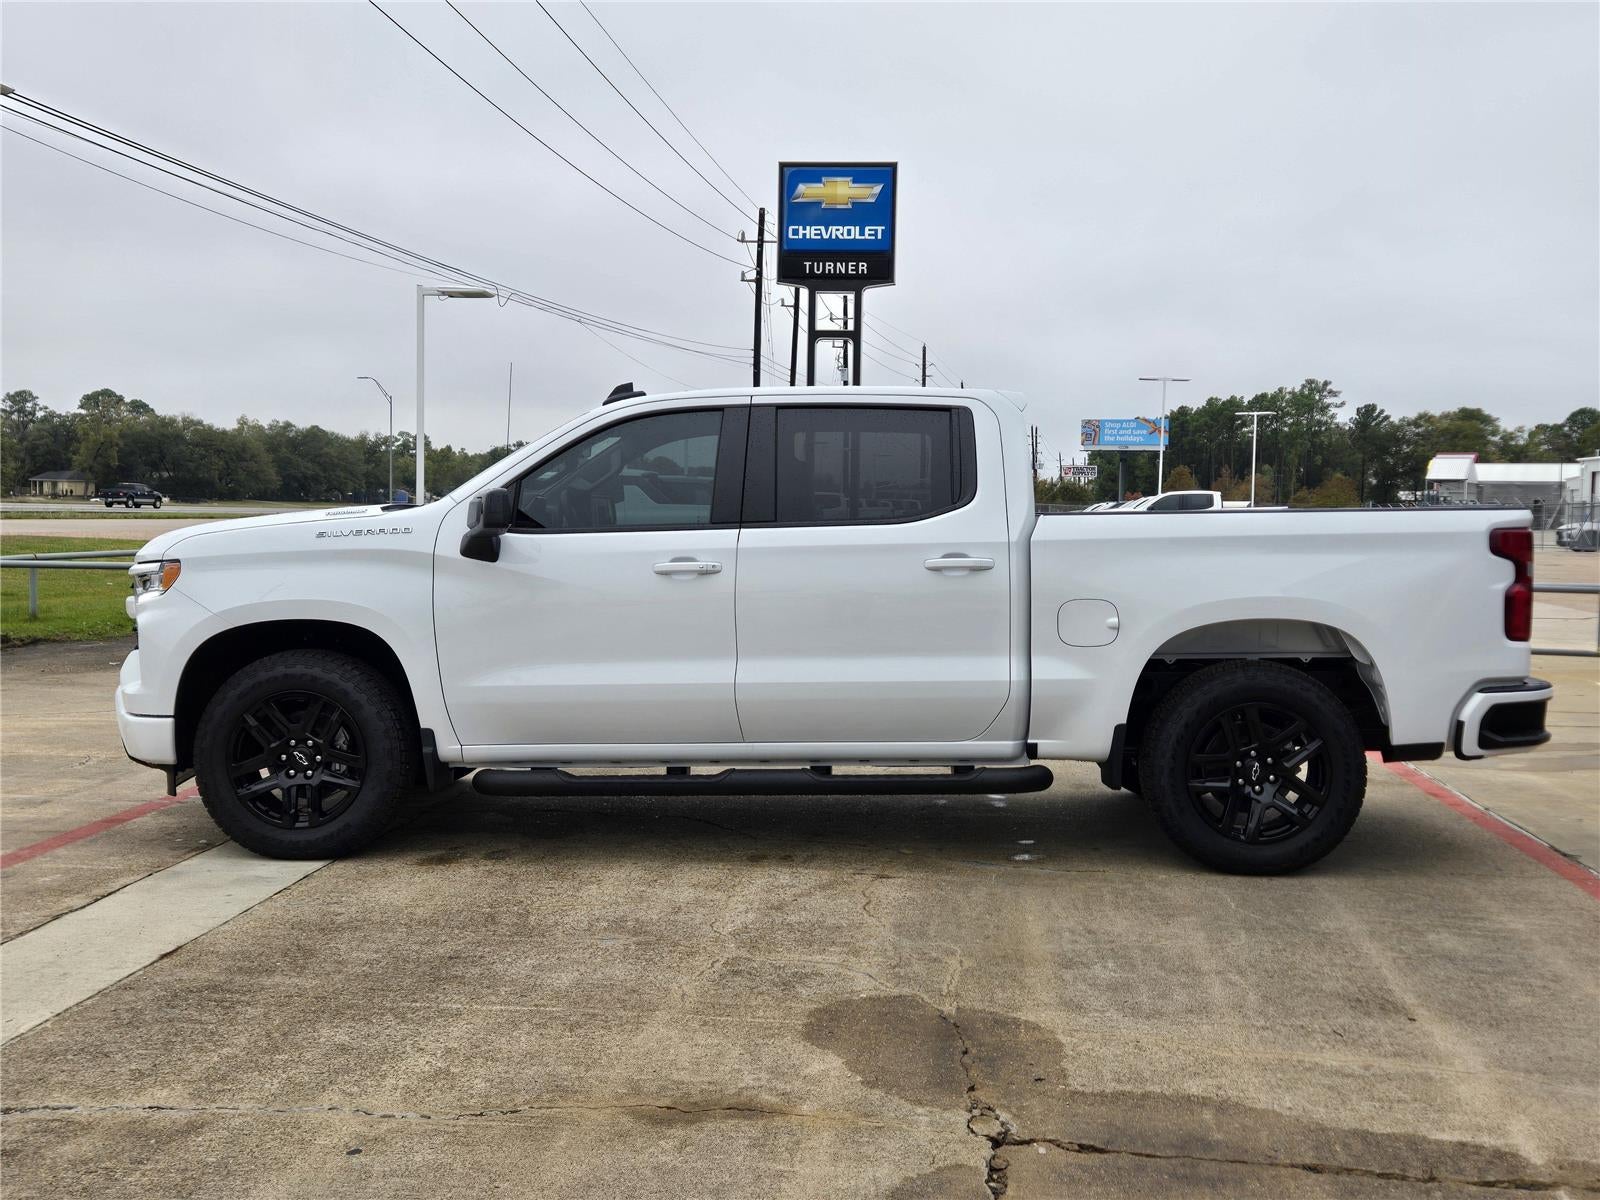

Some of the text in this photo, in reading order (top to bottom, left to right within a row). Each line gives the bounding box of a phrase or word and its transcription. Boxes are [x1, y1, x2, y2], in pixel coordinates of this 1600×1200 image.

[788, 225, 885, 239] CHEVROLET
[804, 262, 868, 274] TURNER
[315, 528, 413, 538] SILVERADO
